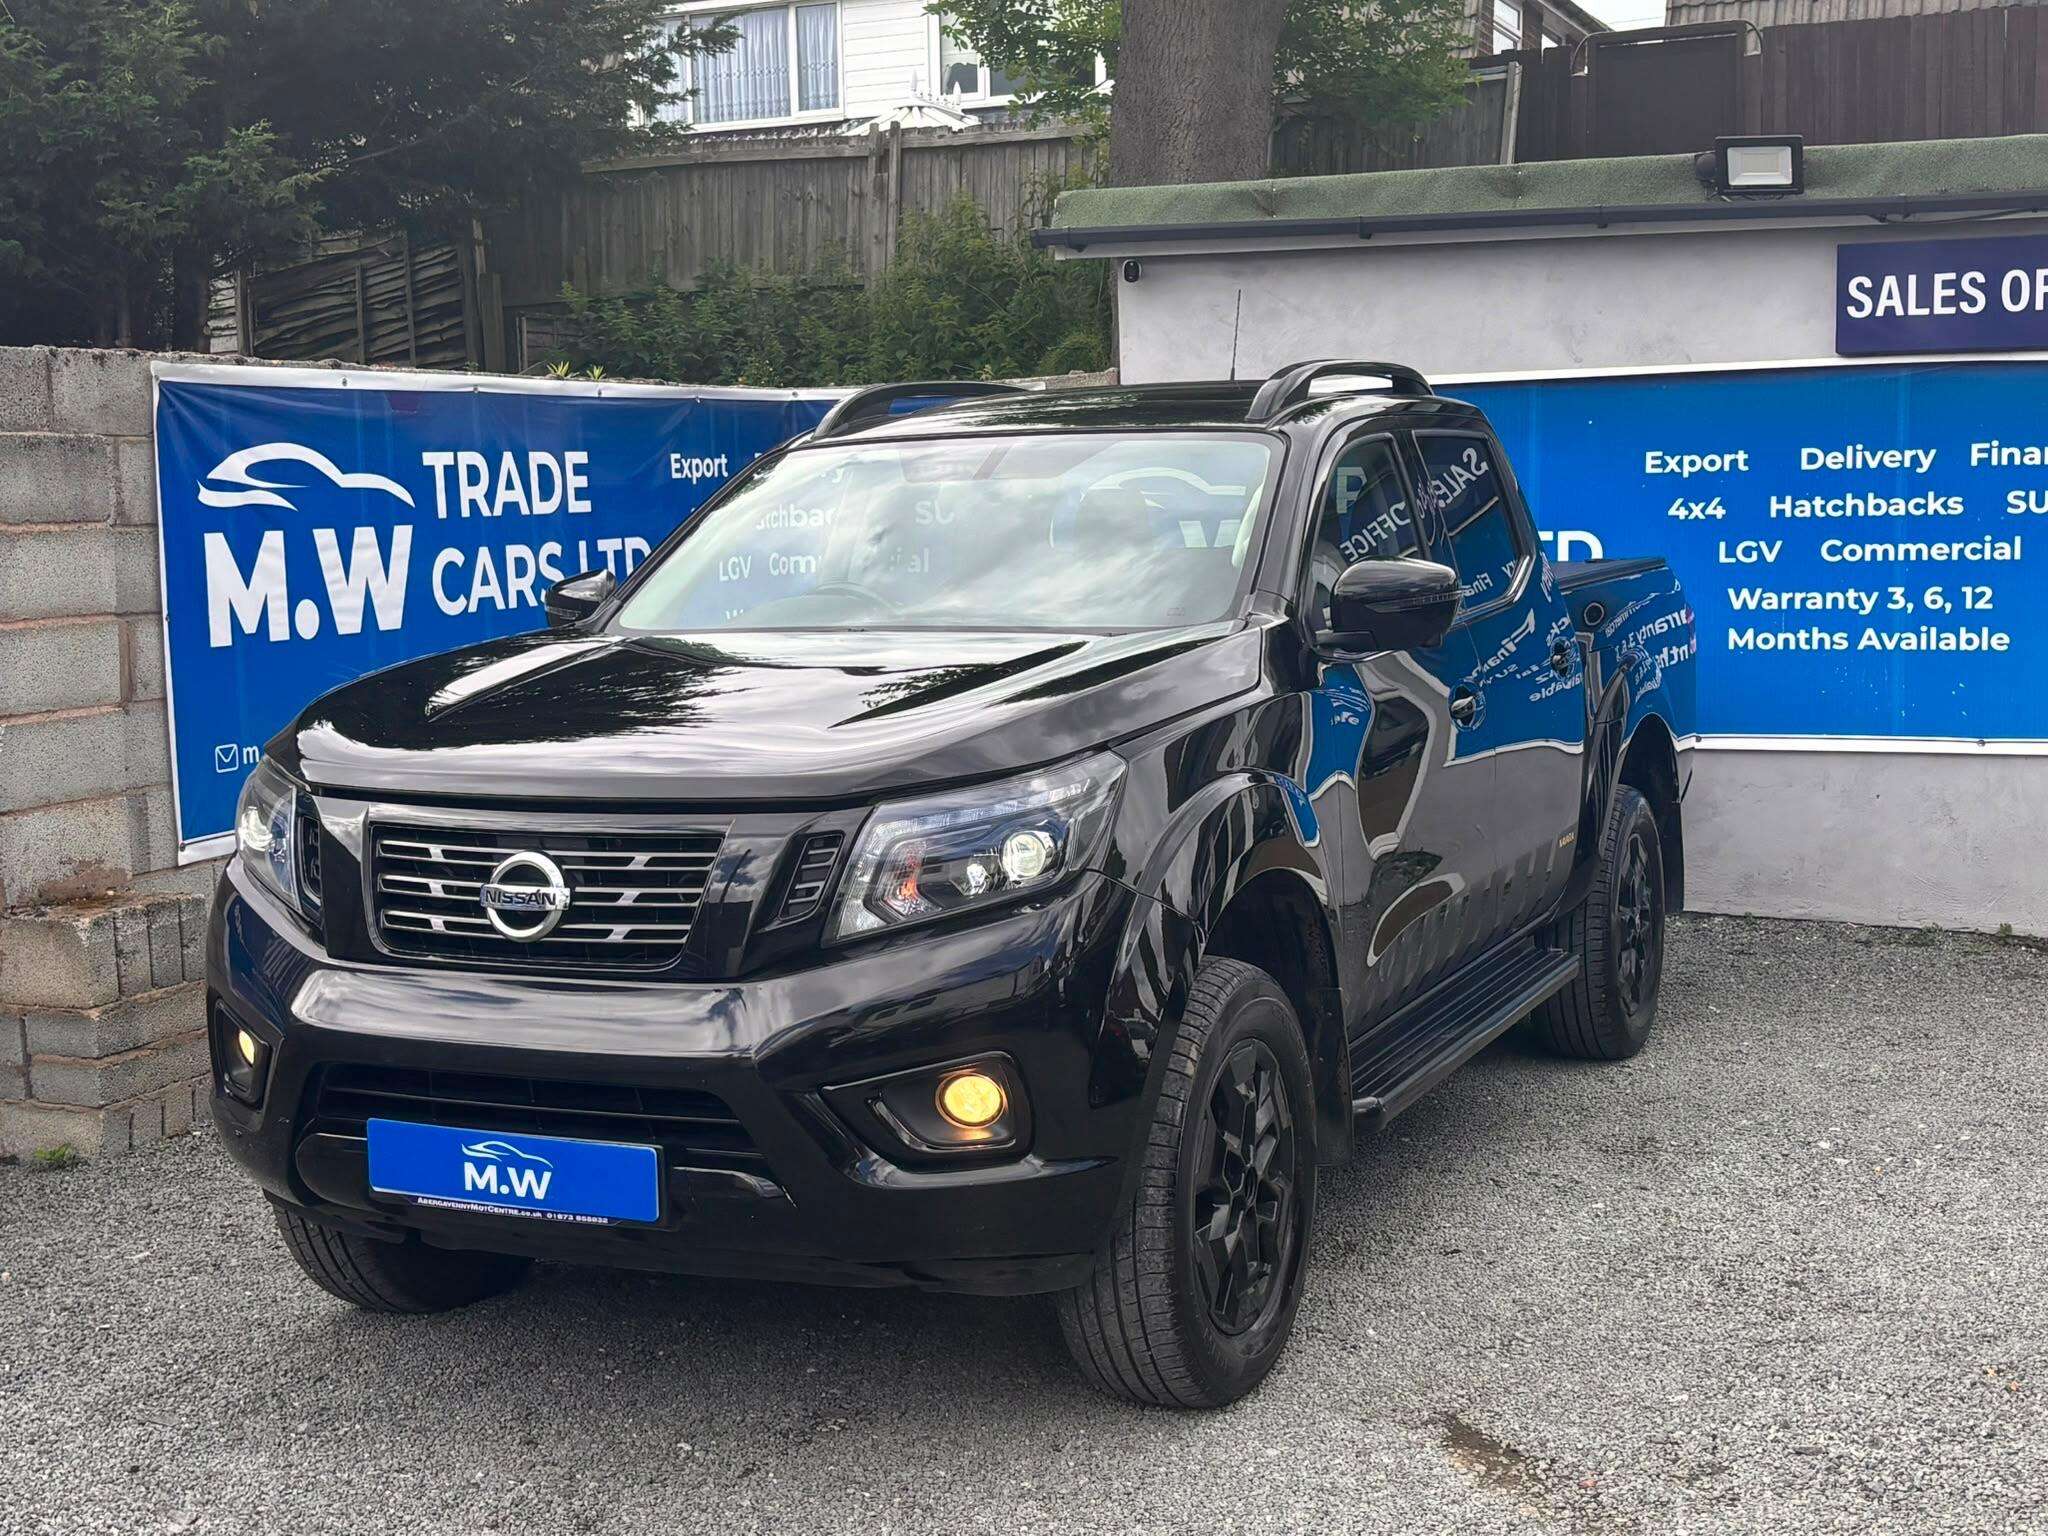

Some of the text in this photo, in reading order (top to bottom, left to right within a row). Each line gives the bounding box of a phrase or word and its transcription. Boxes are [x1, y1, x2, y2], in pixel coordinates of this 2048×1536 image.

[1846, 270, 1986, 319] SALES
[670, 453, 728, 485] Export
[1645, 439, 2048, 478] Export Delivery Fina
[422, 451, 592, 519] TRADE
[1667, 496, 1727, 520] 4x4
[1769, 491, 1964, 518] Hatchbacks
[1718, 535, 2022, 563] LGV Commercial
[204, 524, 413, 648] M.W
[432, 541, 566, 616] CARS
[1727, 586, 1994, 614] Warranty 3, 6, 12
[1727, 625, 2011, 651] Months Available
[485, 890, 557, 906] NISSAN
[463, 1162, 552, 1200] M.W
